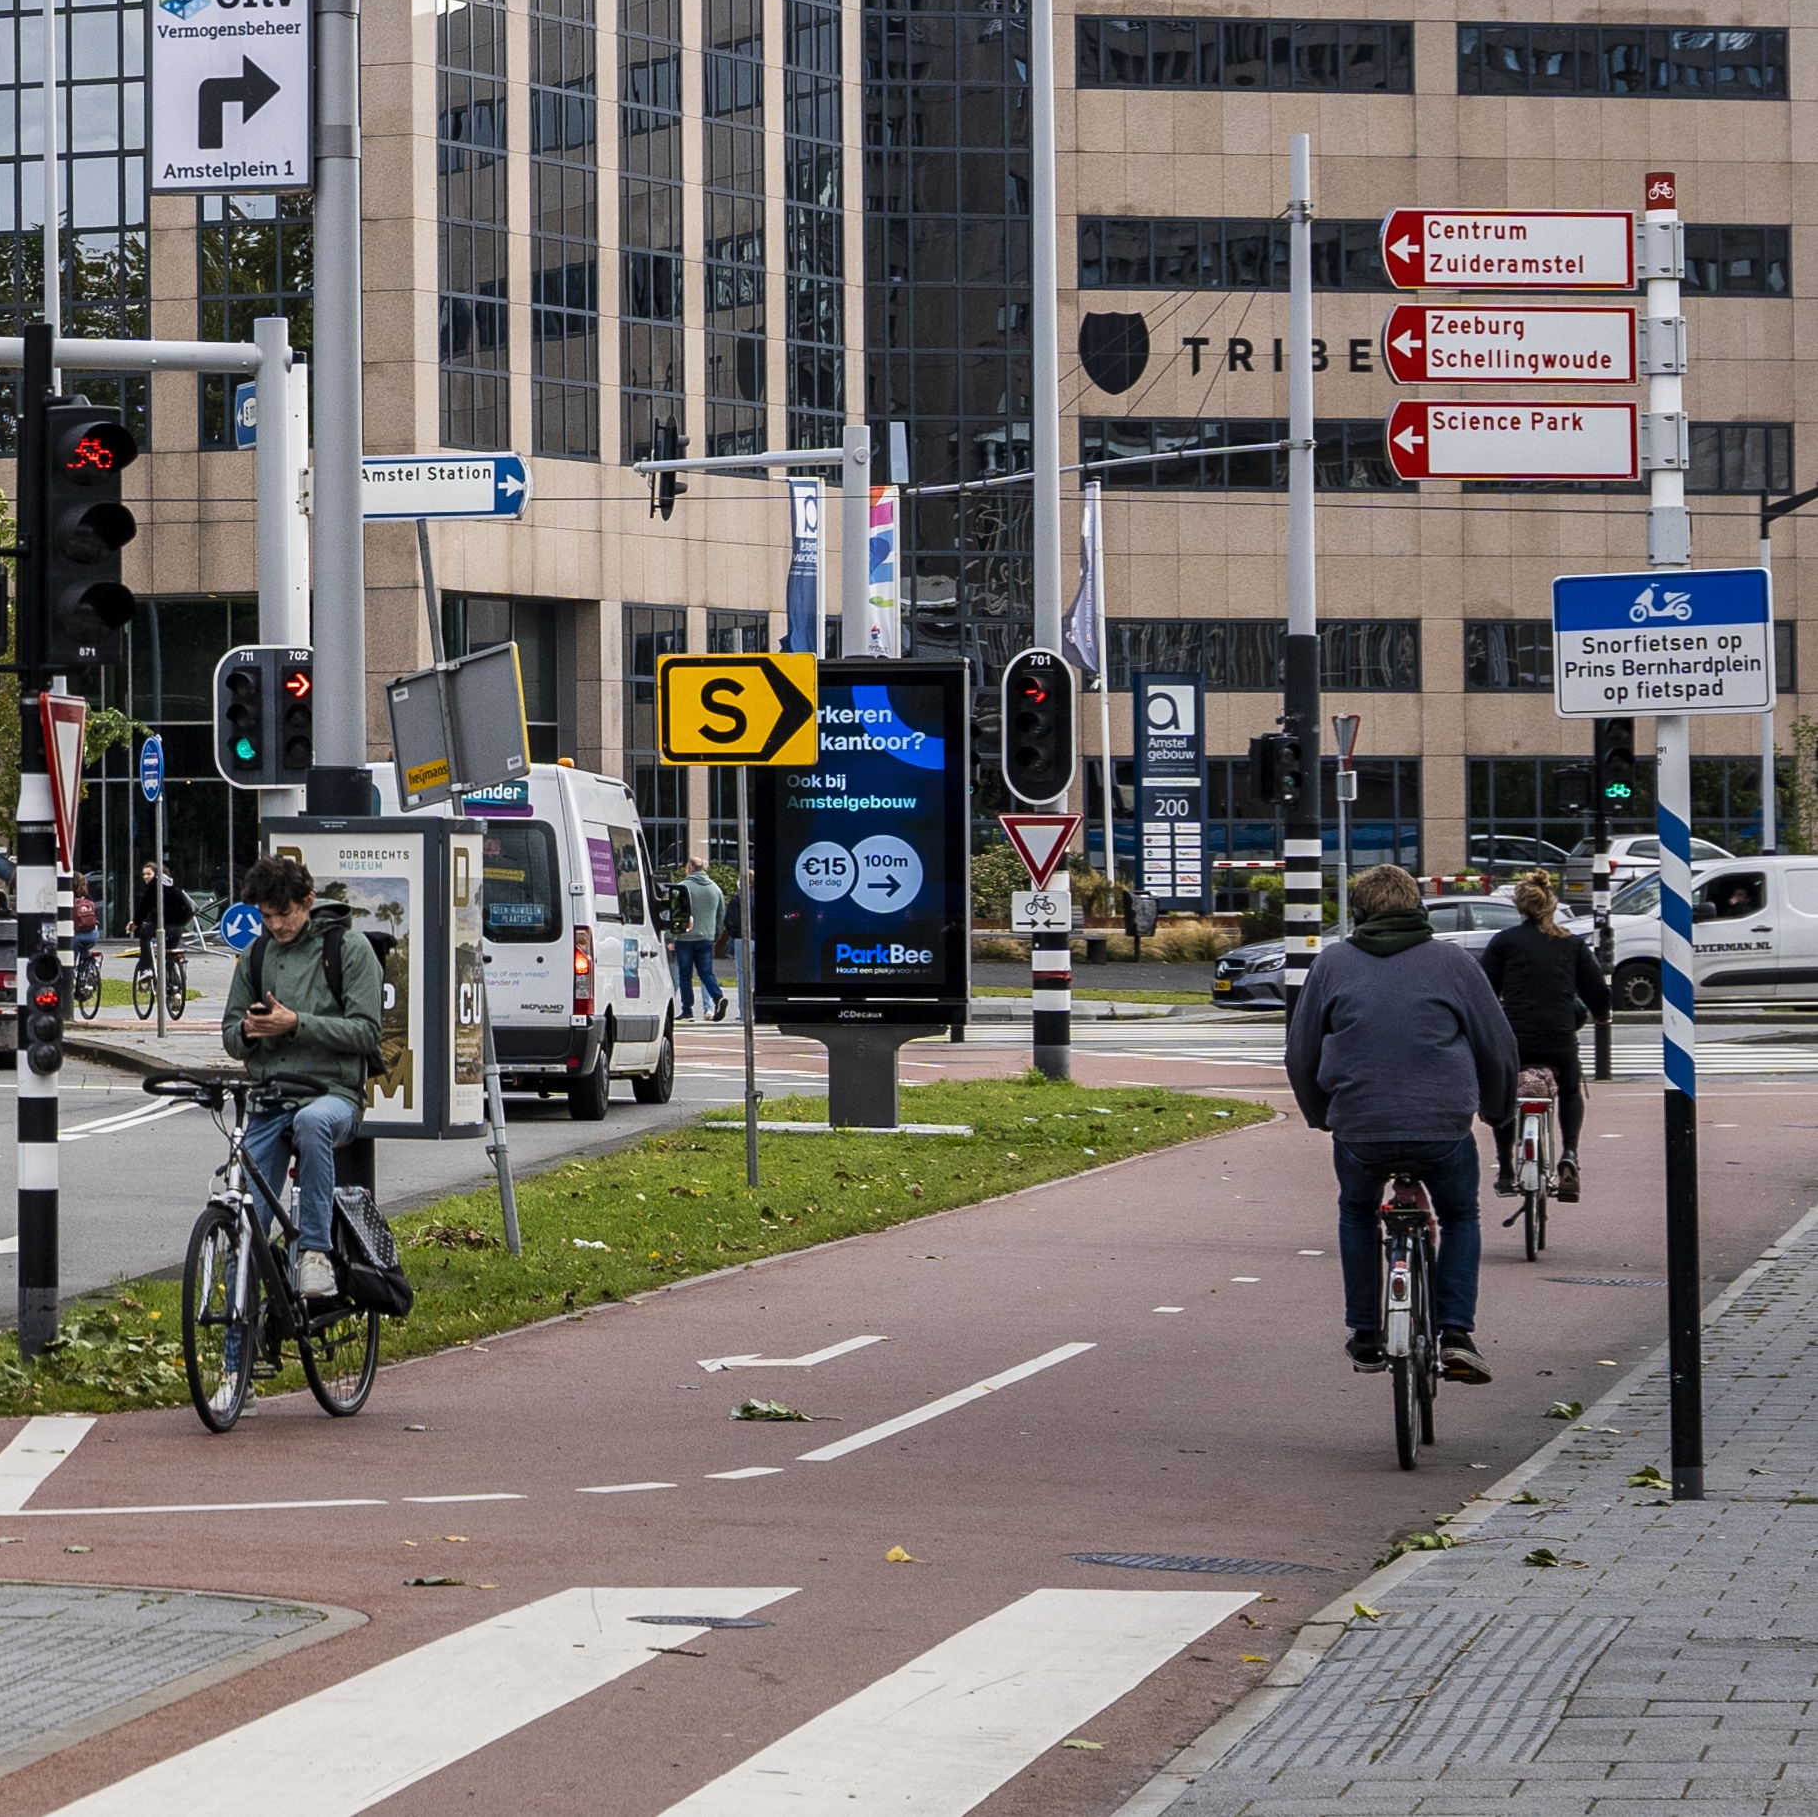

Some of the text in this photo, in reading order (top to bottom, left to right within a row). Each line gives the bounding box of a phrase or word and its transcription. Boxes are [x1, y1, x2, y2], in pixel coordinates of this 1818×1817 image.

[157, 21, 301, 40] Vermogensbeheer
[163, 160, 295, 181] Amstelplein 1
[1427, 220, 1527, 240] Centrum
[1429, 254, 1585, 274] Zuideramstel
[1430, 315, 1525, 340] Zeeburg
[1182, 337, 1374, 377] TRIBE
[1431, 350, 1612, 374] Schellingwoude
[1433, 412, 1584, 431] Science Park
[427, 466, 492, 480] Station
[78, 647, 96, 657] 871
[1582, 634, 1742, 655] Snorfietsen op
[239, 650, 309, 661] 711 702
[1029, 654, 1051, 666] 701
[1565, 655, 1762, 679] Prins Bernhardplein
[1604, 679, 1724, 704] op fietspad
[698, 677, 748, 744] S
[816, 705, 893, 724] rkeren
[820, 731, 926, 751] kantoor?
[1147, 737, 1187, 748] Amstel
[1147, 748, 1196, 762] gebouw
[462, 783, 522, 800] ander
[787, 774, 847, 791] Ook bij
[787, 795, 917, 812] Amstelgebouw
[1154, 799, 1189, 817] 200
[339, 849, 411, 860] DORDRECHTS
[338, 861, 383, 871] MUSEUM
[801, 854, 909, 876] €15 100m
[808, 878, 842, 888] per dag
[492, 905, 507, 915] GEEN
[835, 943, 934, 964] ParkBee
[836, 966, 858, 974] Houdt
[520, 1003, 565, 1011] MOVANO
[838, 1010, 883, 1019] JCDecaux
